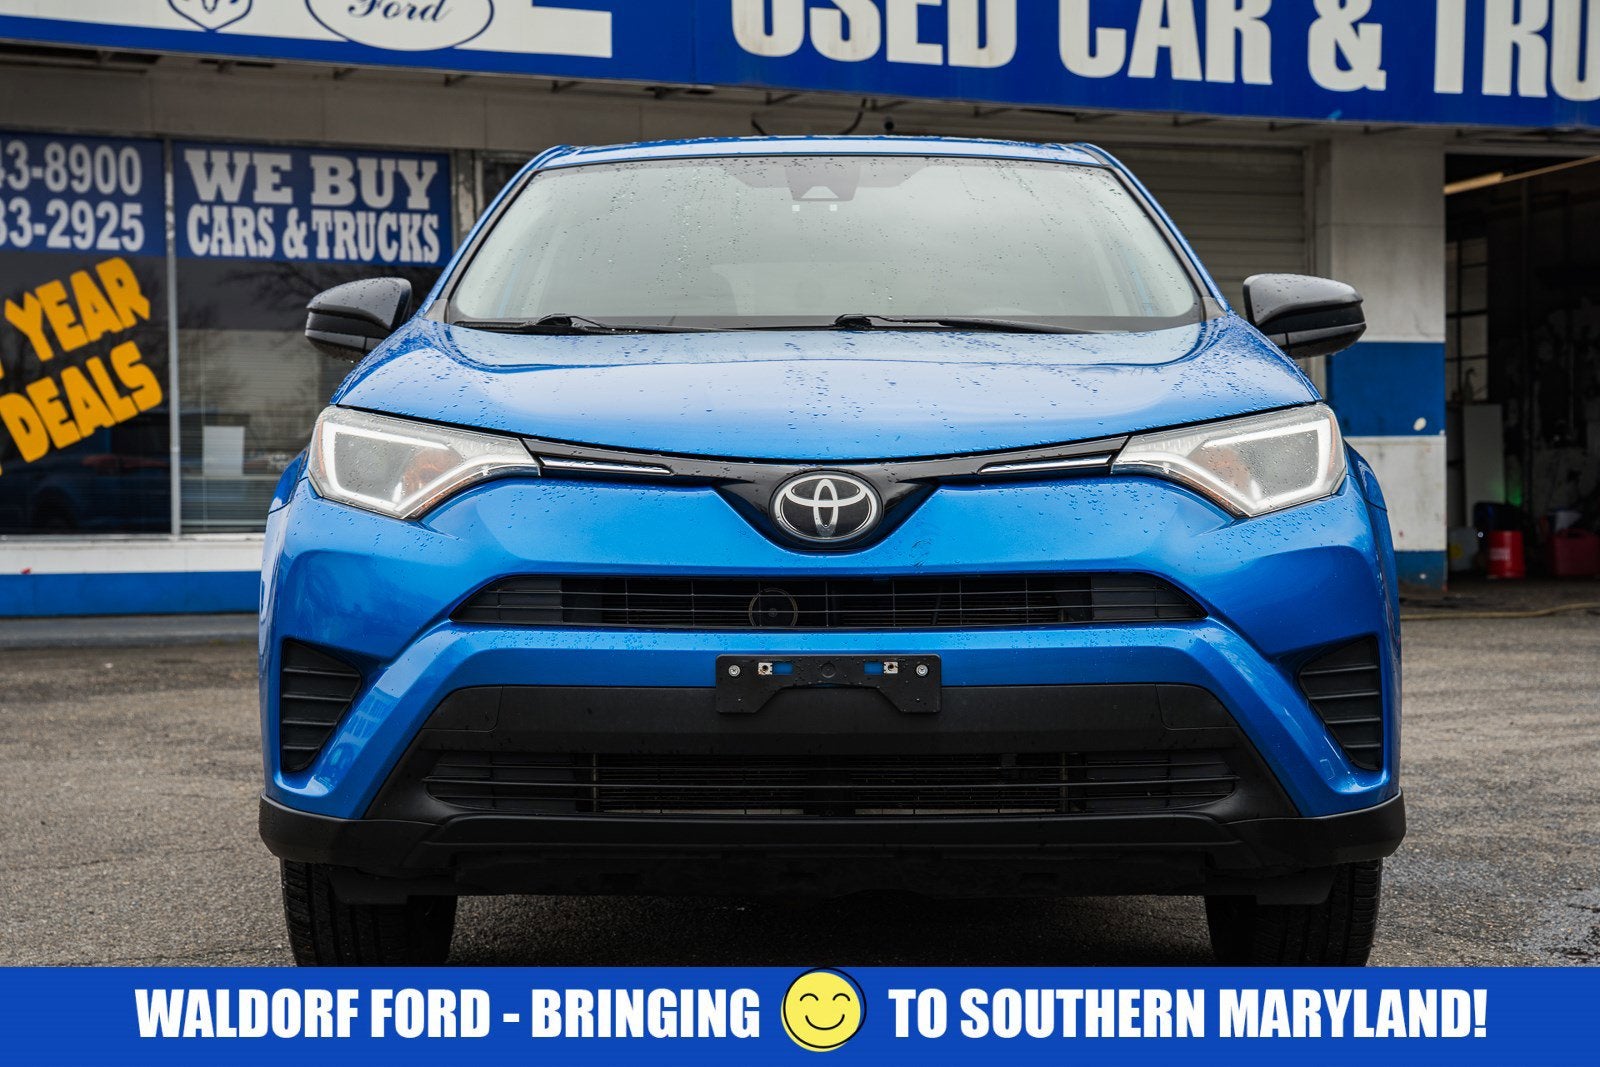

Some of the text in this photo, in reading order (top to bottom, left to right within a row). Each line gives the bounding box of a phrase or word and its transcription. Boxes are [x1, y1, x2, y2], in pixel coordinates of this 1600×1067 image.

[347, 0, 449, 22] Ford
[732, 0, 1017, 68] USED
[1059, 0, 1273, 85] CAR
[1308, 0, 1387, 92] &
[0, 140, 142, 196] 3-8900
[185, 149, 439, 209] WE BUY
[186, 204, 440, 264] CARS & TRUCKS
[5, 257, 151, 362] YEAR
[0, 341, 163, 463] DEALS
